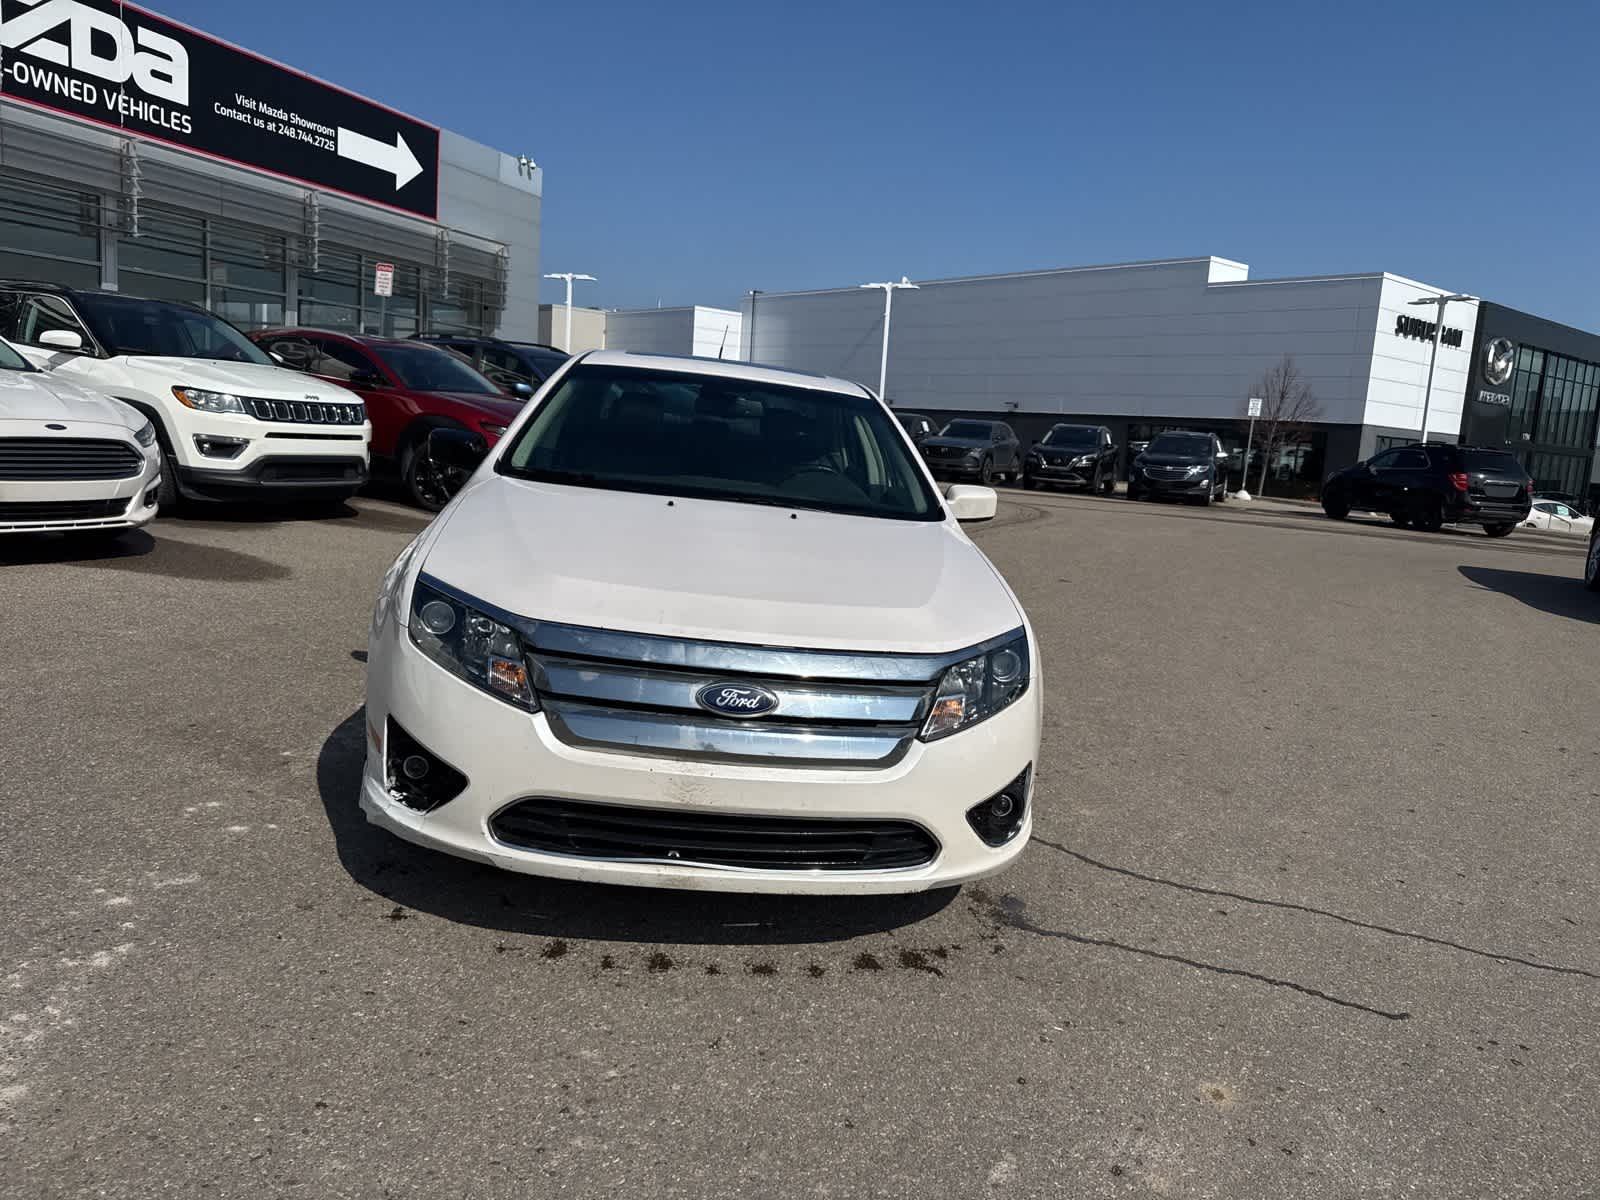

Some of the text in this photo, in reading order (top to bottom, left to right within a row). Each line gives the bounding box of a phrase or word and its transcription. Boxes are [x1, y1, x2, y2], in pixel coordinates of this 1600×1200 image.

[0, 60, 192, 135] -OWNED VEHICLES
[235, 93, 335, 137] Visit Mazda Showroom
[214, 102, 335, 151] Contact us at 248.744.2725
[716, 688, 761, 709] Ford
